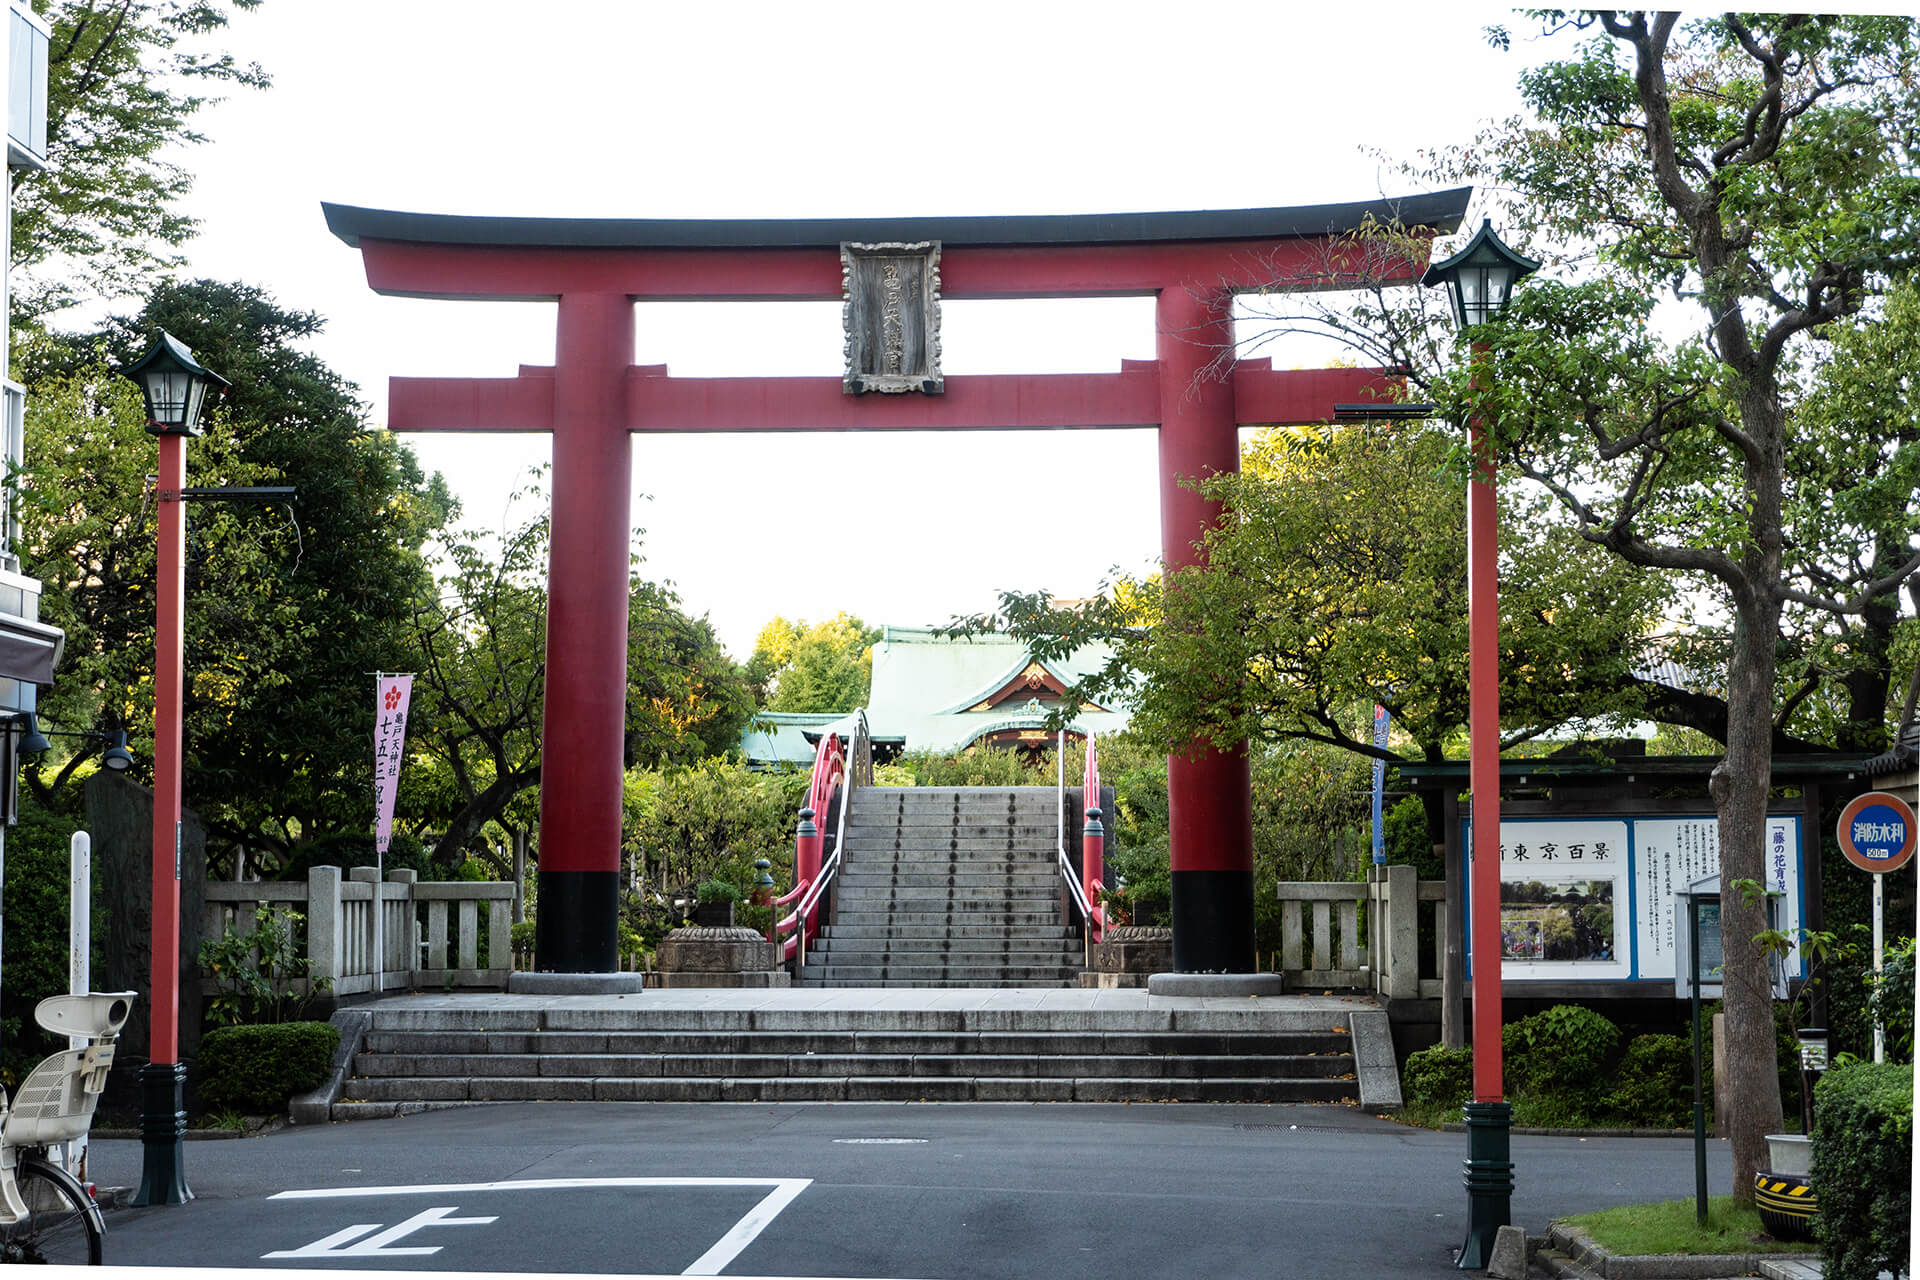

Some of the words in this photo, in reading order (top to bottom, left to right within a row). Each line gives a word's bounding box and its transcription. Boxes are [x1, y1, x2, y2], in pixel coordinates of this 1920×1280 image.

[388, 711, 405, 777] 亀戸天神社
[1853, 821, 1904, 844] 消防水利
